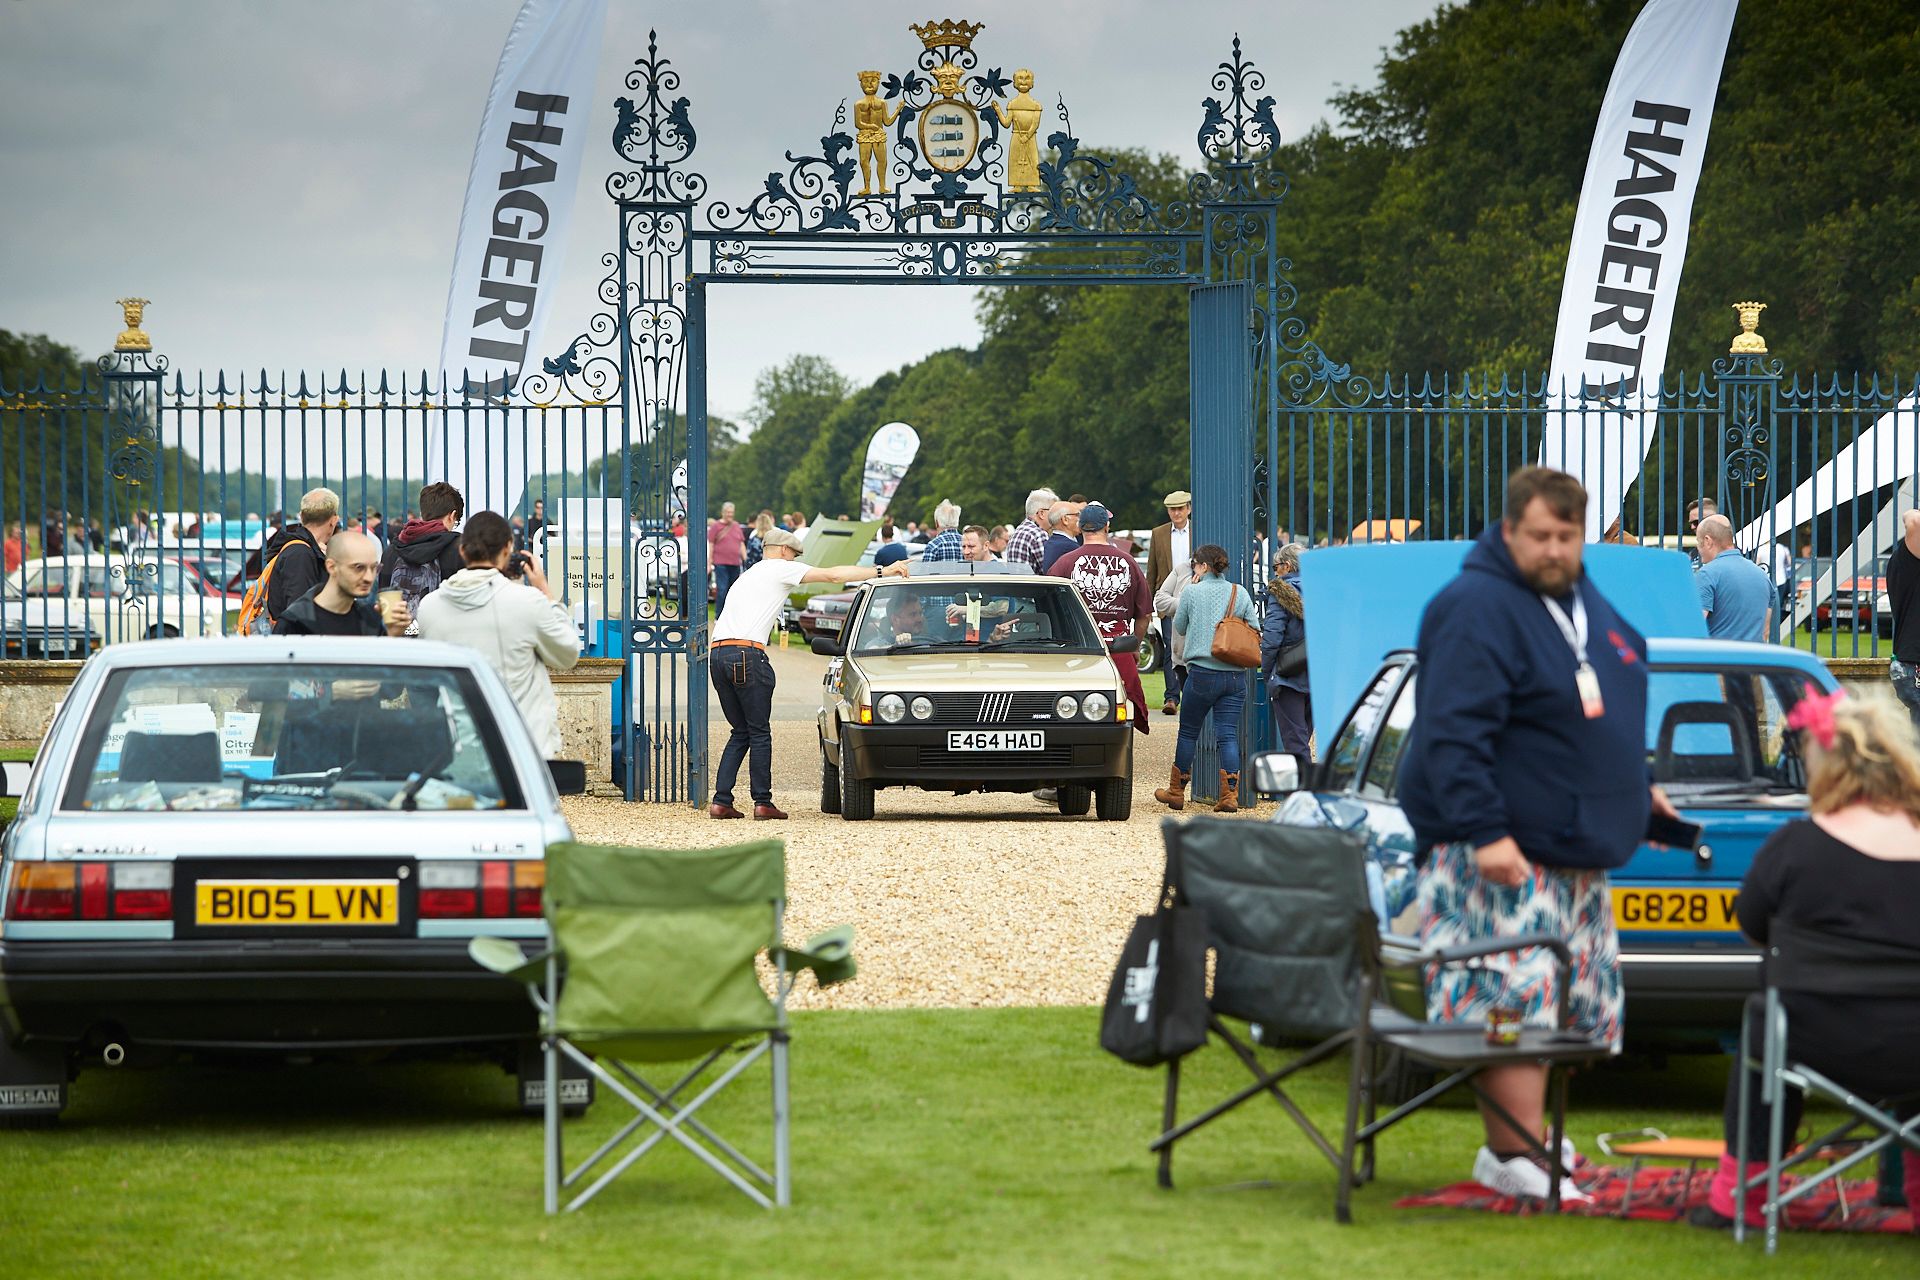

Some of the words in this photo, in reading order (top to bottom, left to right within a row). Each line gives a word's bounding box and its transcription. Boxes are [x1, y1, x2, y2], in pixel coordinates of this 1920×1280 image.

[940, 218, 956, 227] ME
[962, 205, 997, 219] OBLIGE
[469, 90, 569, 405] HAGERTY
[1583, 100, 1691, 420] HAGERTY
[591, 572, 615, 580] Had
[1084, 555, 1122, 572] XXXL
[950, 733, 1000, 749] E464
[1005, 733, 1042, 749] HAD
[211, 888, 296, 919] B105
[308, 888, 383, 919] LVN
[1622, 893, 1707, 922] G828
